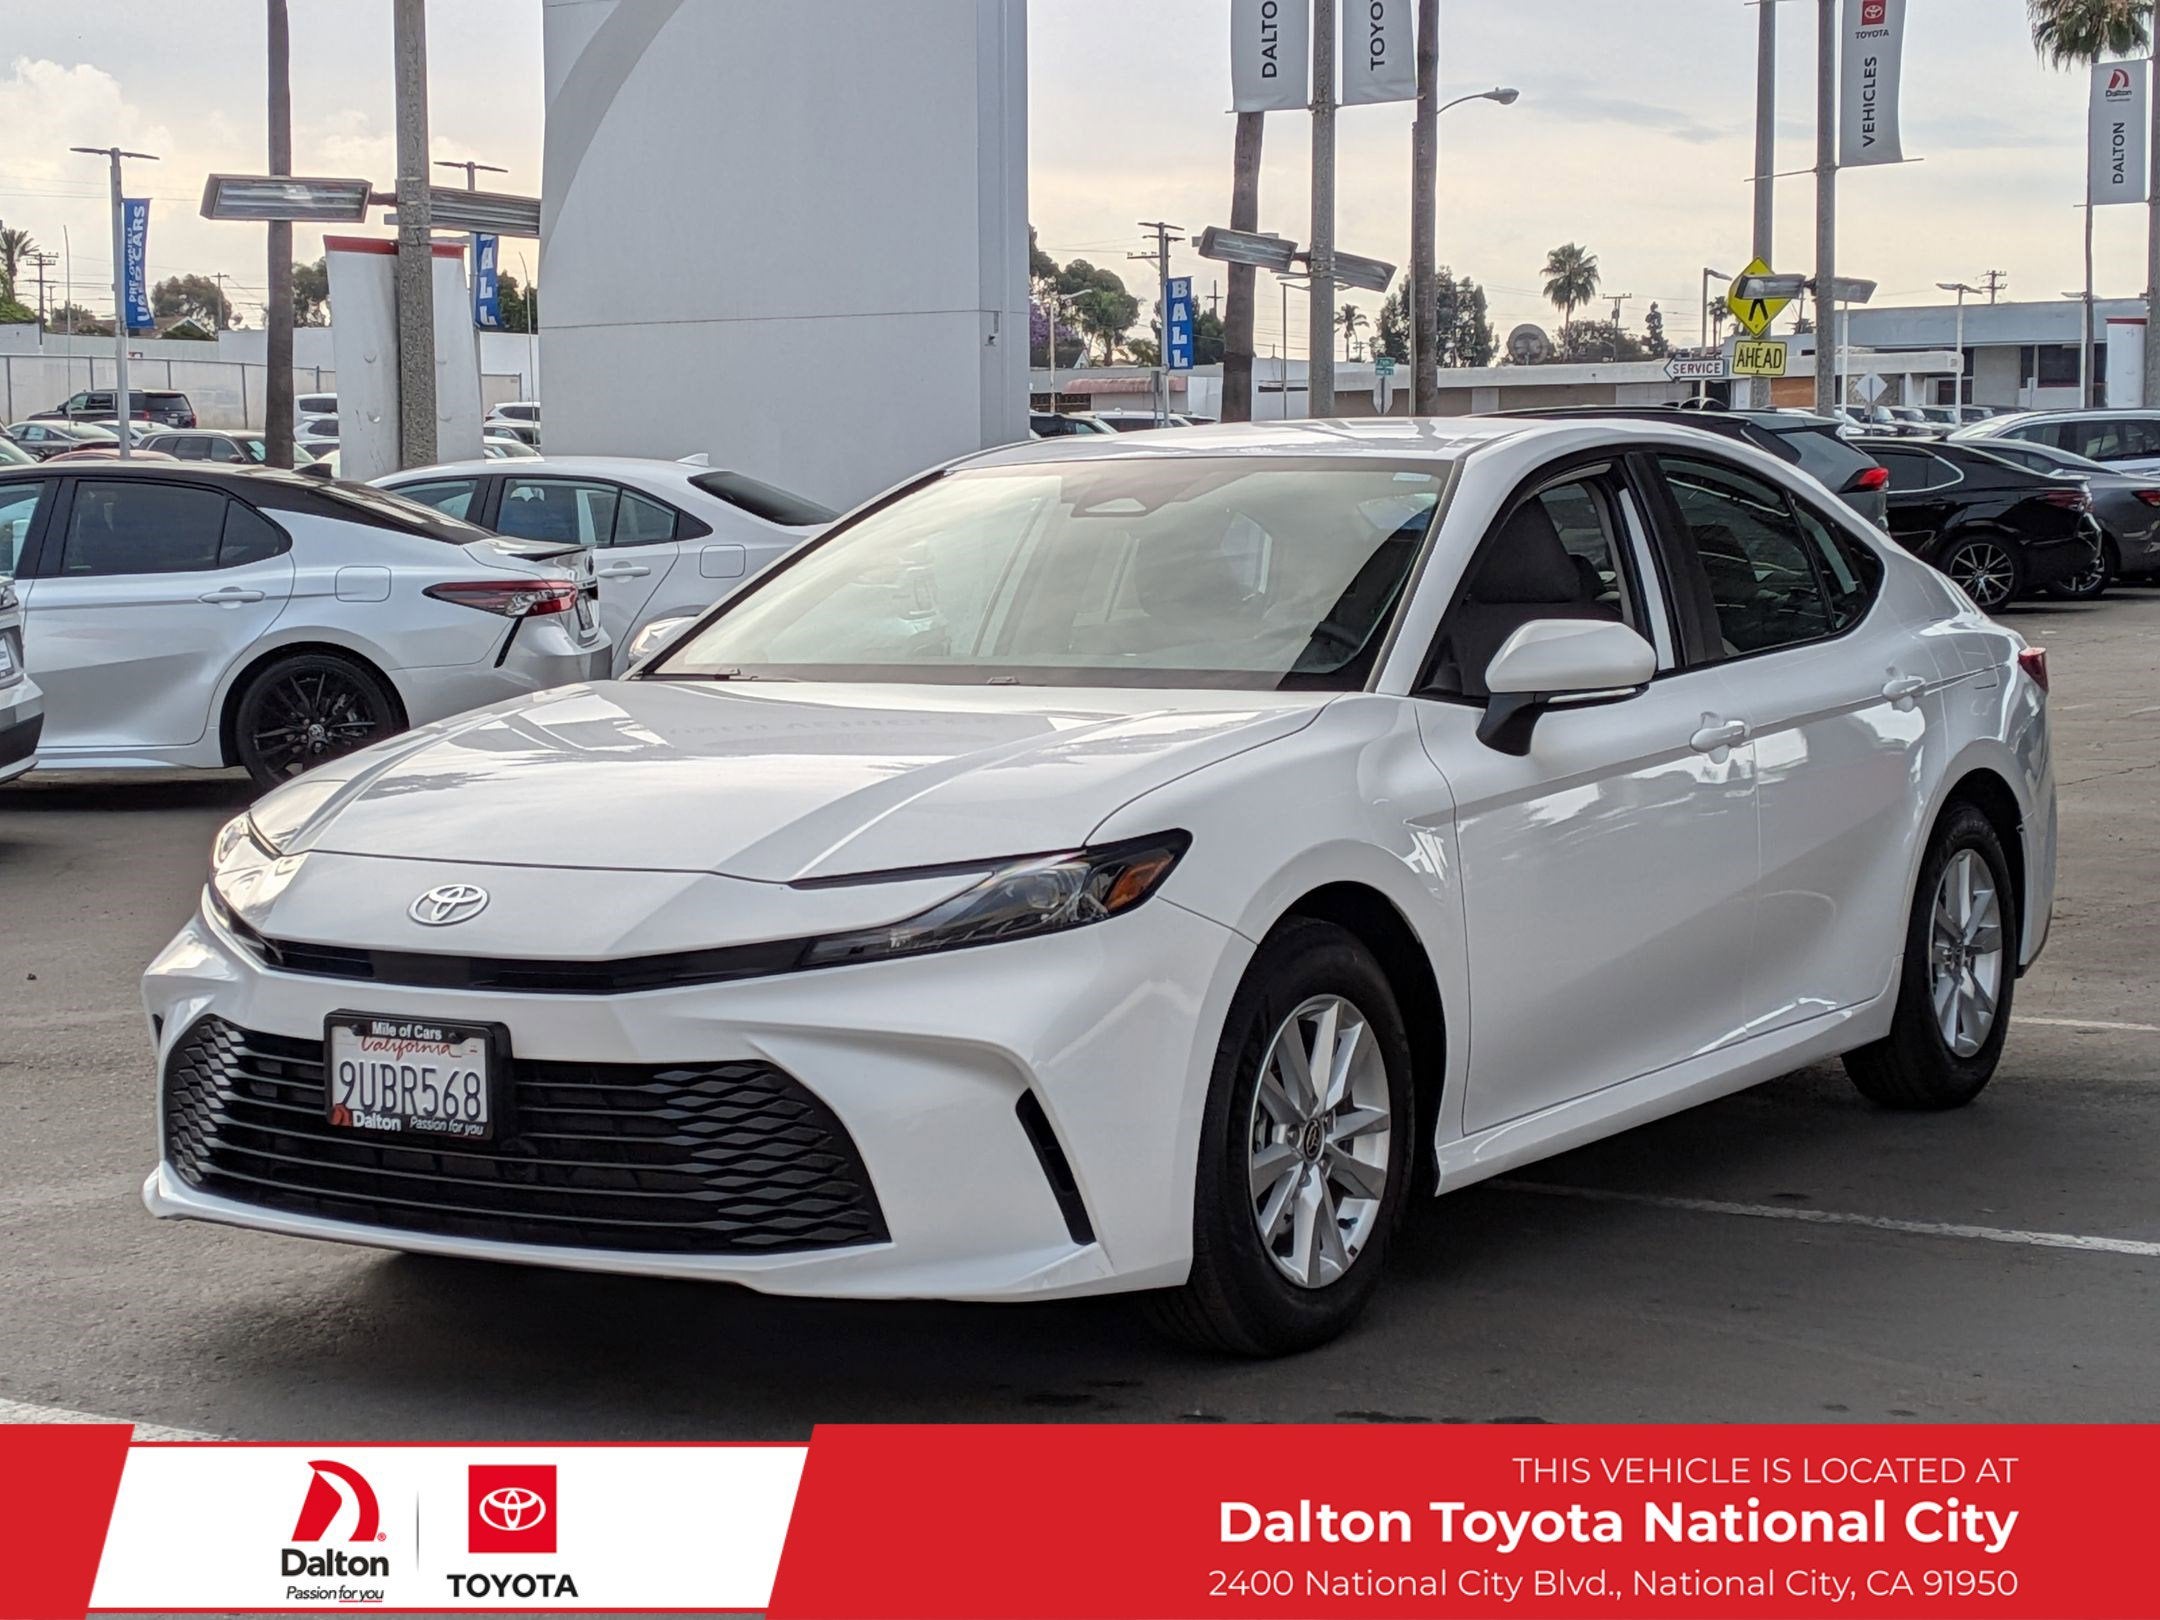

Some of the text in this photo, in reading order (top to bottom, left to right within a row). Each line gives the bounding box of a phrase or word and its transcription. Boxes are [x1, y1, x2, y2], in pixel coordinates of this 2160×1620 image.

[1370, 0, 1387, 71] TOYO
[1856, 29, 1889, 39] TOYOTA
[1863, 56, 1877, 148] VEHICLES
[2105, 89, 2132, 98] Dalton
[2113, 122, 2125, 184] DALTON
[132, 205, 145, 262] CARS
[480, 234, 499, 325] ALL
[1171, 280, 1188, 368] BALL
[1672, 363, 1720, 375] SERVICE
[1736, 347, 1782, 369] AHEAD
[360, 1035, 462, 1060] California
[372, 1022, 442, 1041] Mile of Cars
[339, 1061, 481, 1121] 9UBR568
[352, 1110, 484, 1137] Dalton Passion for you
